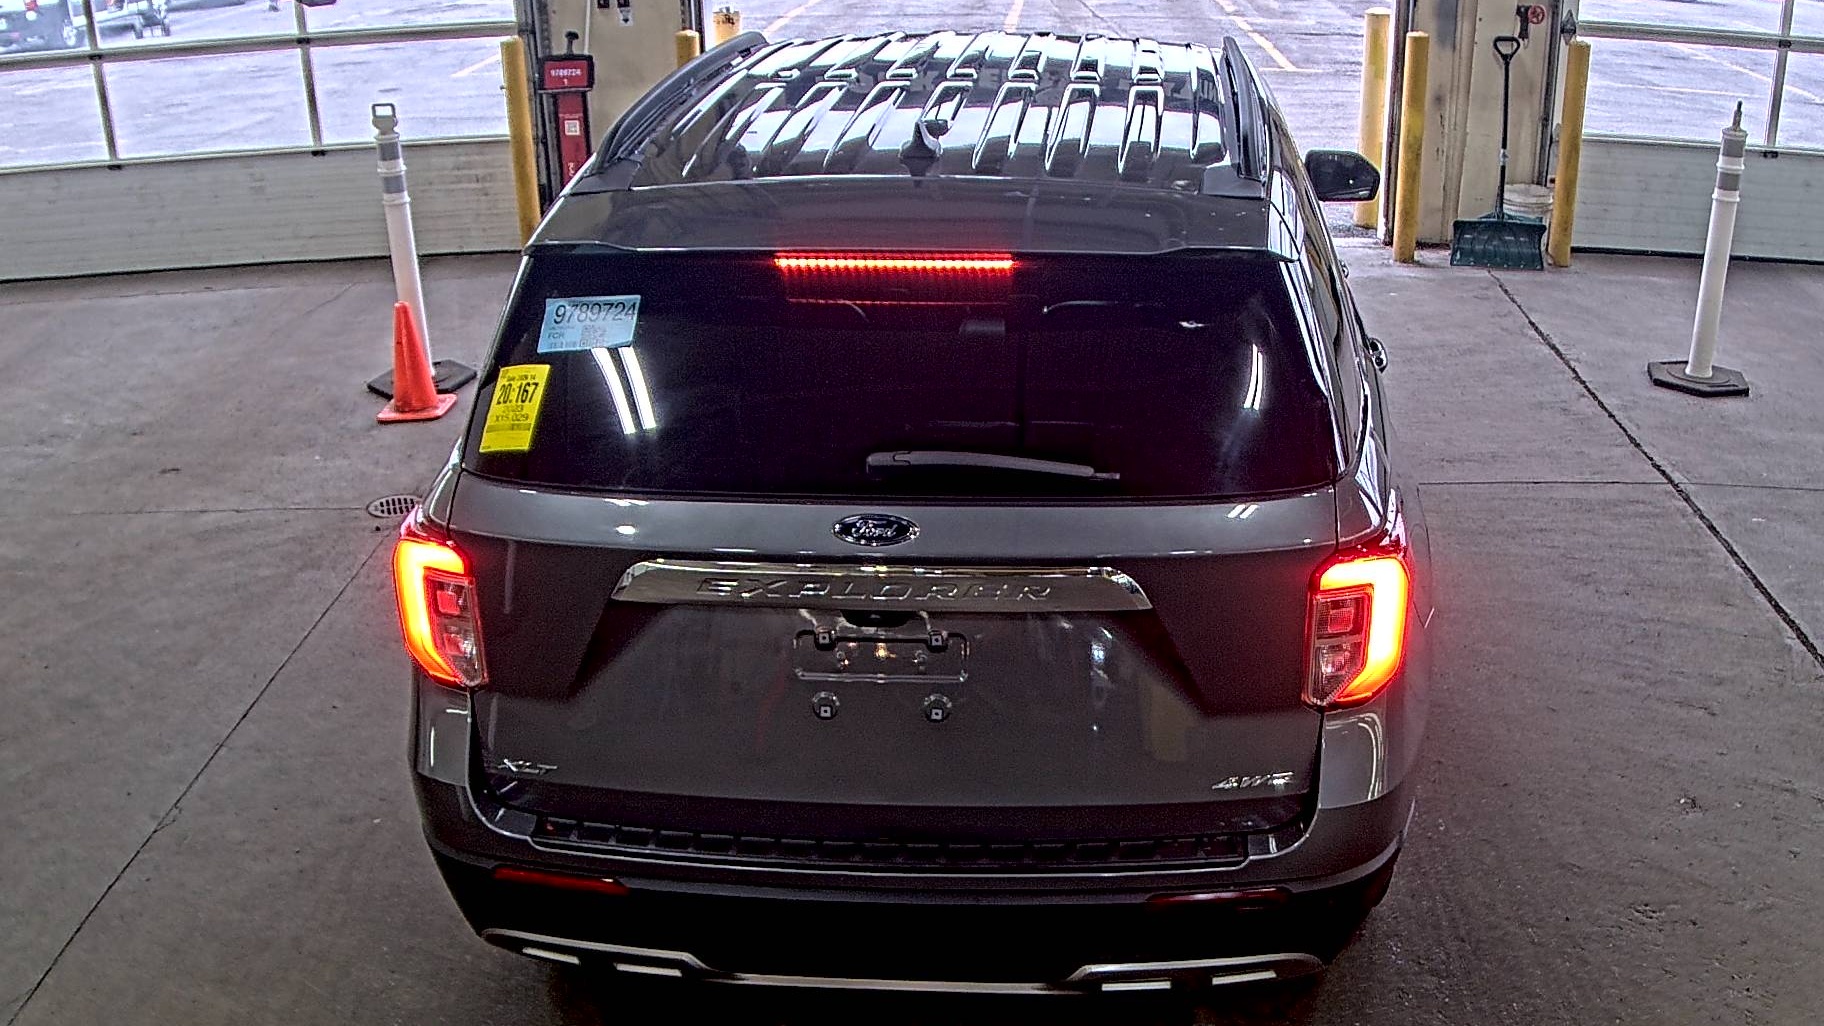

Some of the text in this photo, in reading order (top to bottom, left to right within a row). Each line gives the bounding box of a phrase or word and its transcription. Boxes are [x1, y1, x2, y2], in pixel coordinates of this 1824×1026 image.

[553, 301, 638, 325] 9789724
[696, 577, 1052, 602] EXPLORER
[497, 757, 559, 775] XLT
